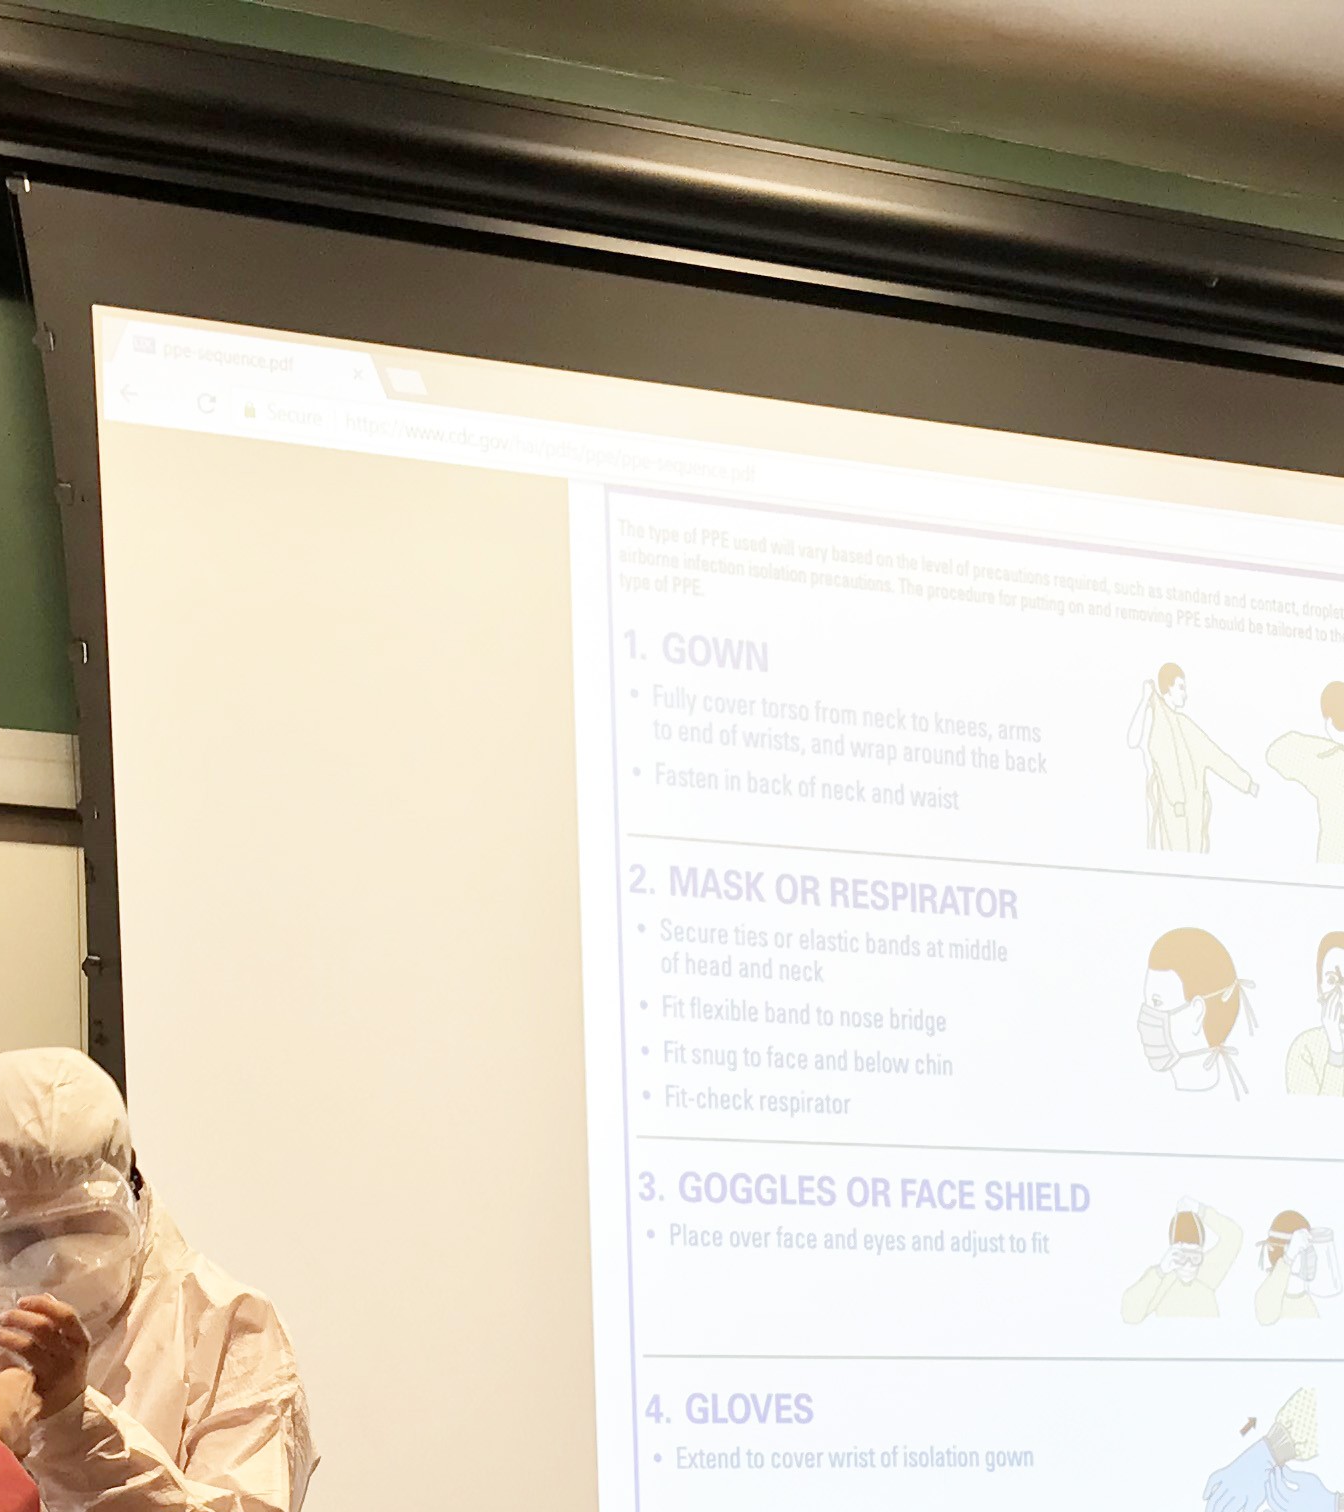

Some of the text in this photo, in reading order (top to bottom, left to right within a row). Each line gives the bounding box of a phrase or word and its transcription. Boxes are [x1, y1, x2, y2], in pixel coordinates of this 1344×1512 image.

[267, 401, 323, 426] Secure
[617, 518, 645, 538] The
[648, 525, 680, 544] type
[683, 528, 697, 544] of
[702, 528, 730, 549] PPE
[733, 537, 767, 553] used
[770, 538, 795, 556] will
[798, 544, 828, 564] vary
[831, 545, 873, 565] based
[874, 552, 893, 568] on
[894, 553, 918, 571] the
[921, 555, 954, 575] level
[956, 560, 970, 576] of
[973, 565, 1051, 586] precautions
[1053, 576, 1113, 595] required,
[1114, 581, 1145, 597] such
[1148, 585, 1163, 599] as
[1166, 586, 1220, 606] standard
[1224, 593, 1246, 609] and
[1250, 598, 1299, 617] contact,
[1302, 601, 1344, 621] droplet
[619, 573, 704, 597] type of PPE.
[619, 547, 679, 571] airborne
[683, 553, 744, 579] infection
[748, 560, 807, 583] isolation
[810, 571, 895, 594] precautions.
[898, 577, 923, 597] The
[927, 585, 996, 605] procedure
[998, 589, 1017, 607] for
[1020, 595, 1065, 616] putting
[1067, 600, 1084, 614] on
[1088, 602, 1112, 617] and
[1115, 606, 1173, 628] removing
[1177, 609, 1201, 628] PPE
[1204, 614, 1245, 632] should
[1248, 617, 1263, 634] be
[1264, 619, 1312, 640] tailored
[1315, 621, 1327, 641] to
[624, 629, 768, 672] 1. GOWN
[653, 684, 1041, 743] Fully cover torso from neck to knees, arms
[653, 719, 1047, 774] to end of wrists, and wrap around the back
[656, 762, 959, 810] Fasten in back of neck and waist
[629, 864, 1018, 919] 2. MASK OR RESPIRATOR
[661, 918, 1007, 962] Secure ties or elastic bands at middle
[661, 951, 824, 983] of head and neck
[663, 995, 946, 1037] Fit flexible band to nose bridge
[664, 1040, 953, 1076] Fit snug to face and below chin
[665, 1084, 851, 1118] Fit-check respirator
[639, 1171, 1090, 1212] 3. GOGGLES OR FACE SHIELD
[670, 1223, 1050, 1258] Place over face and eyes and adjust to fit
[645, 1393, 814, 1424] 4. GLOVES
[676, 1445, 1034, 1472] Extend to cover wrist of isolation gown
